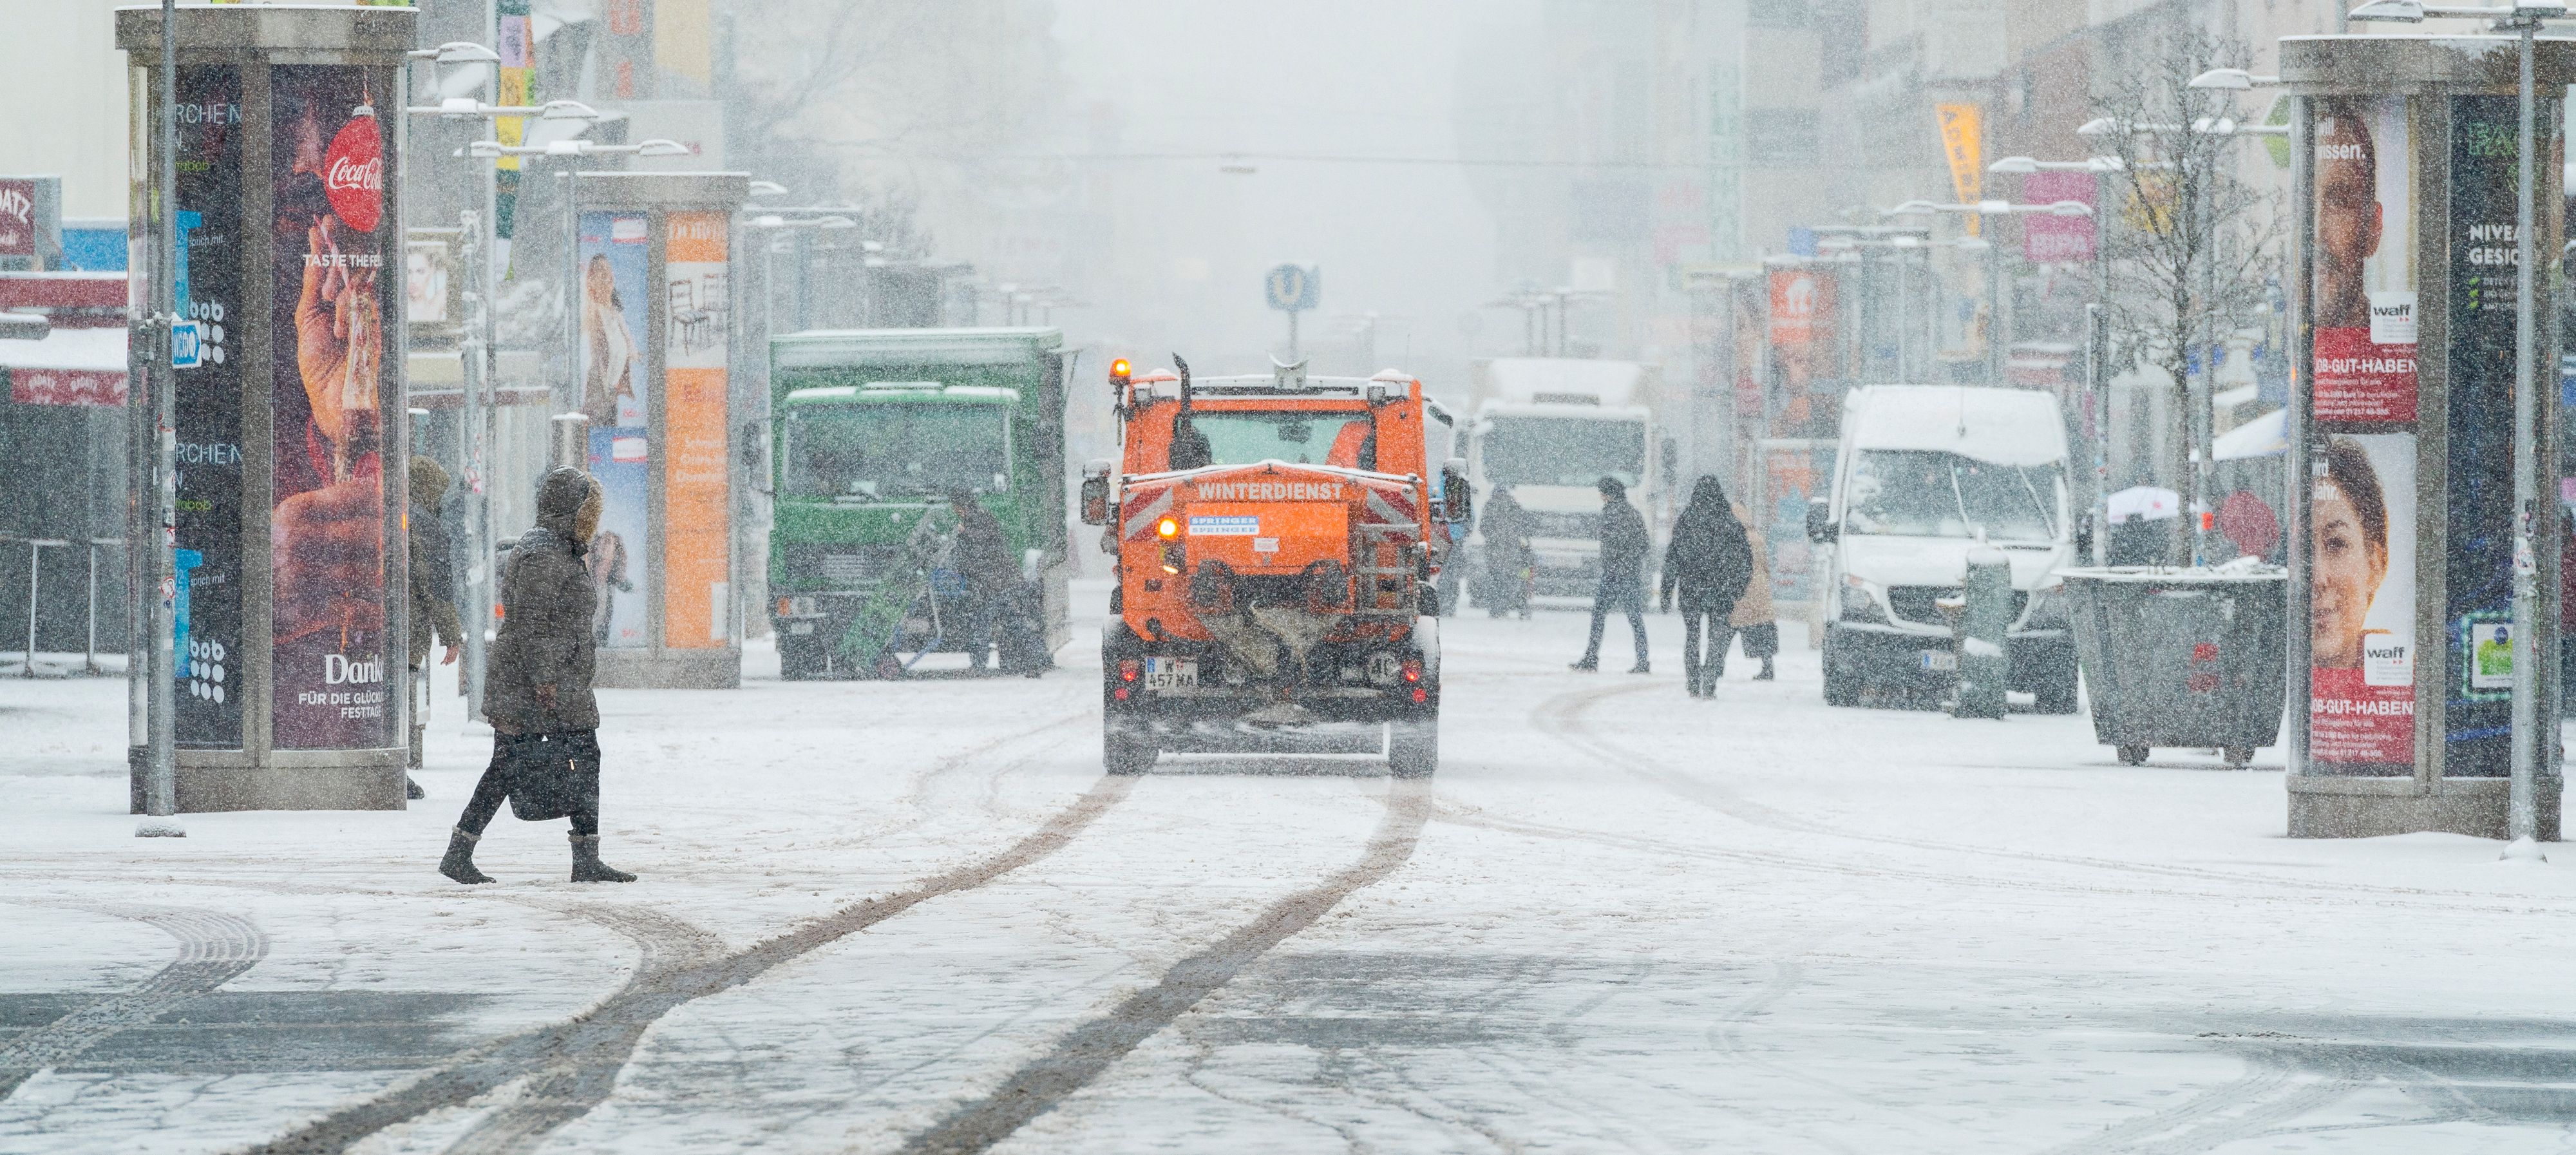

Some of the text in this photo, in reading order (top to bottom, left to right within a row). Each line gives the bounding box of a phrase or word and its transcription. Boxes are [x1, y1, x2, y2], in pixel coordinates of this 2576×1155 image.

[0, 188, 30, 224] ATZ
[303, 254, 346, 267] TASTE
[350, 254, 369, 267] THE
[1274, 271, 1302, 303] U
[190, 298, 224, 322] bob
[2373, 303, 2412, 316] waff
[1198, 482, 1343, 500] WINTERDIENST
[190, 638, 225, 662] bob
[2367, 646, 2404, 658] waff
[299, 691, 327, 705] FÜR
[331, 692, 350, 705] DIE
